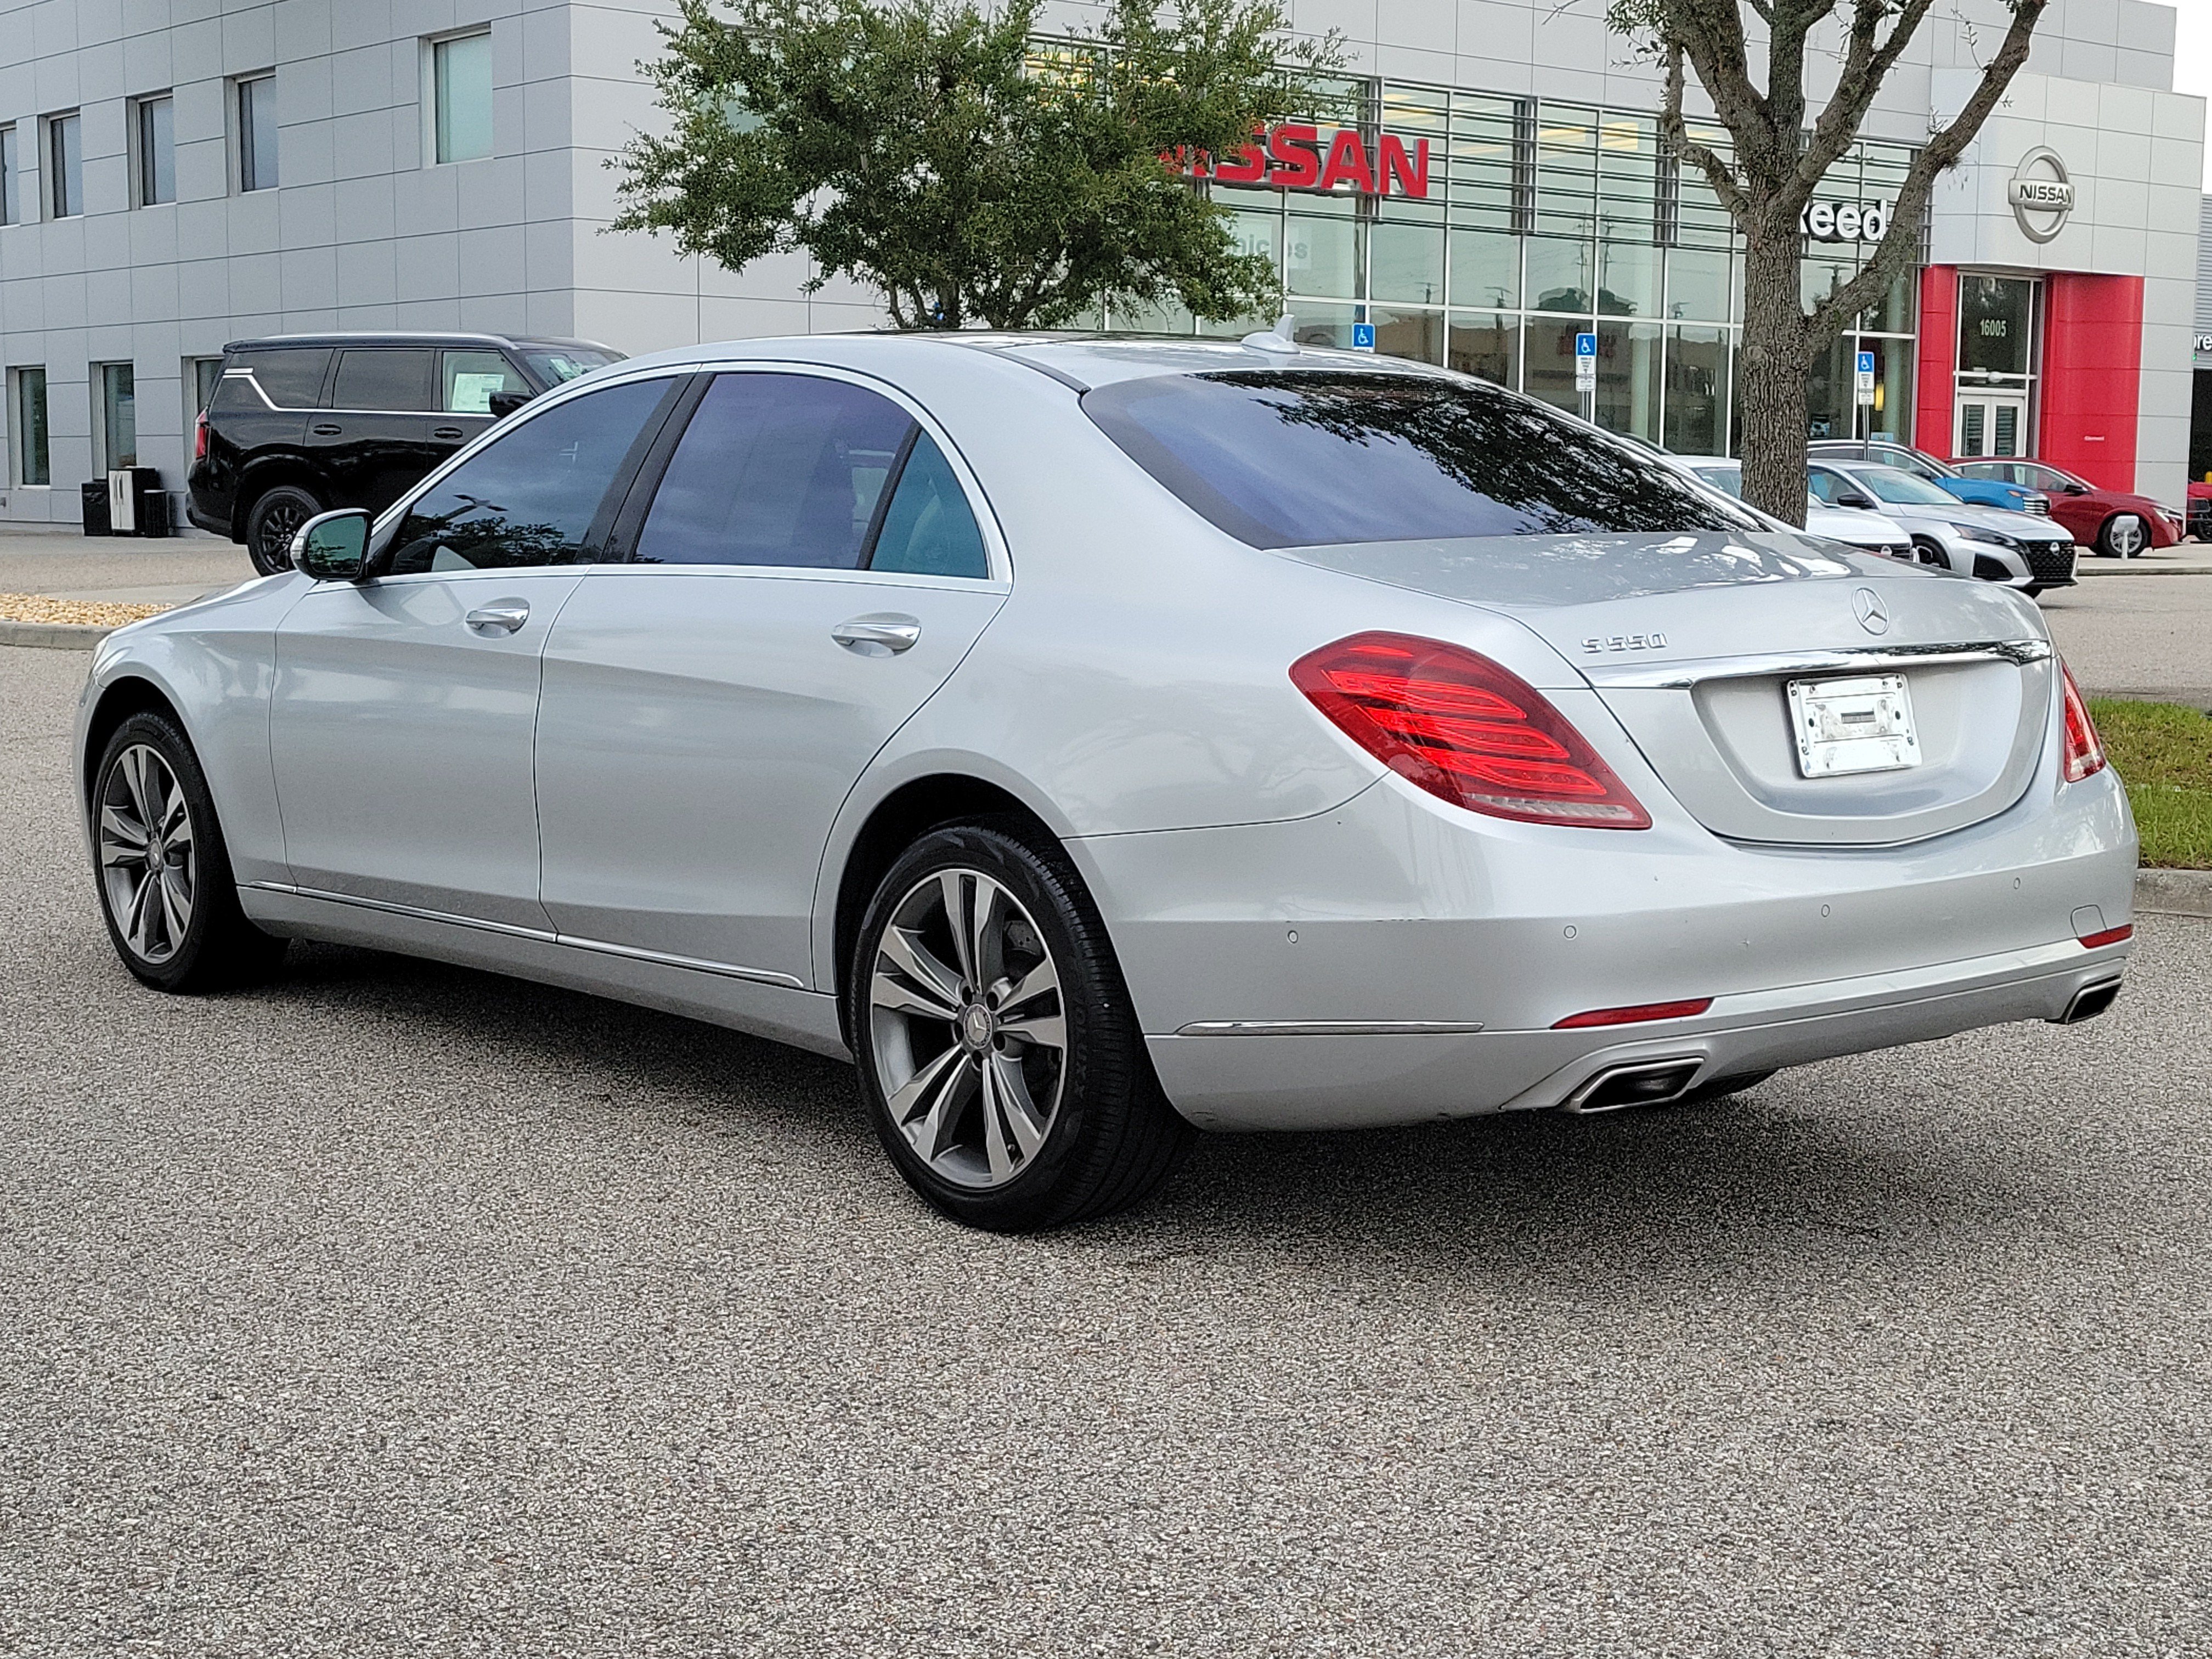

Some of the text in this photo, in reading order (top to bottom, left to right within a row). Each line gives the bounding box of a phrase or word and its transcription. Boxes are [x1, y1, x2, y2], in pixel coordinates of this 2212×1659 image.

[2019, 184, 2072, 204] NISSAN
[1979, 318, 2007, 337] 16005
[1581, 633, 1668, 654] S 550
